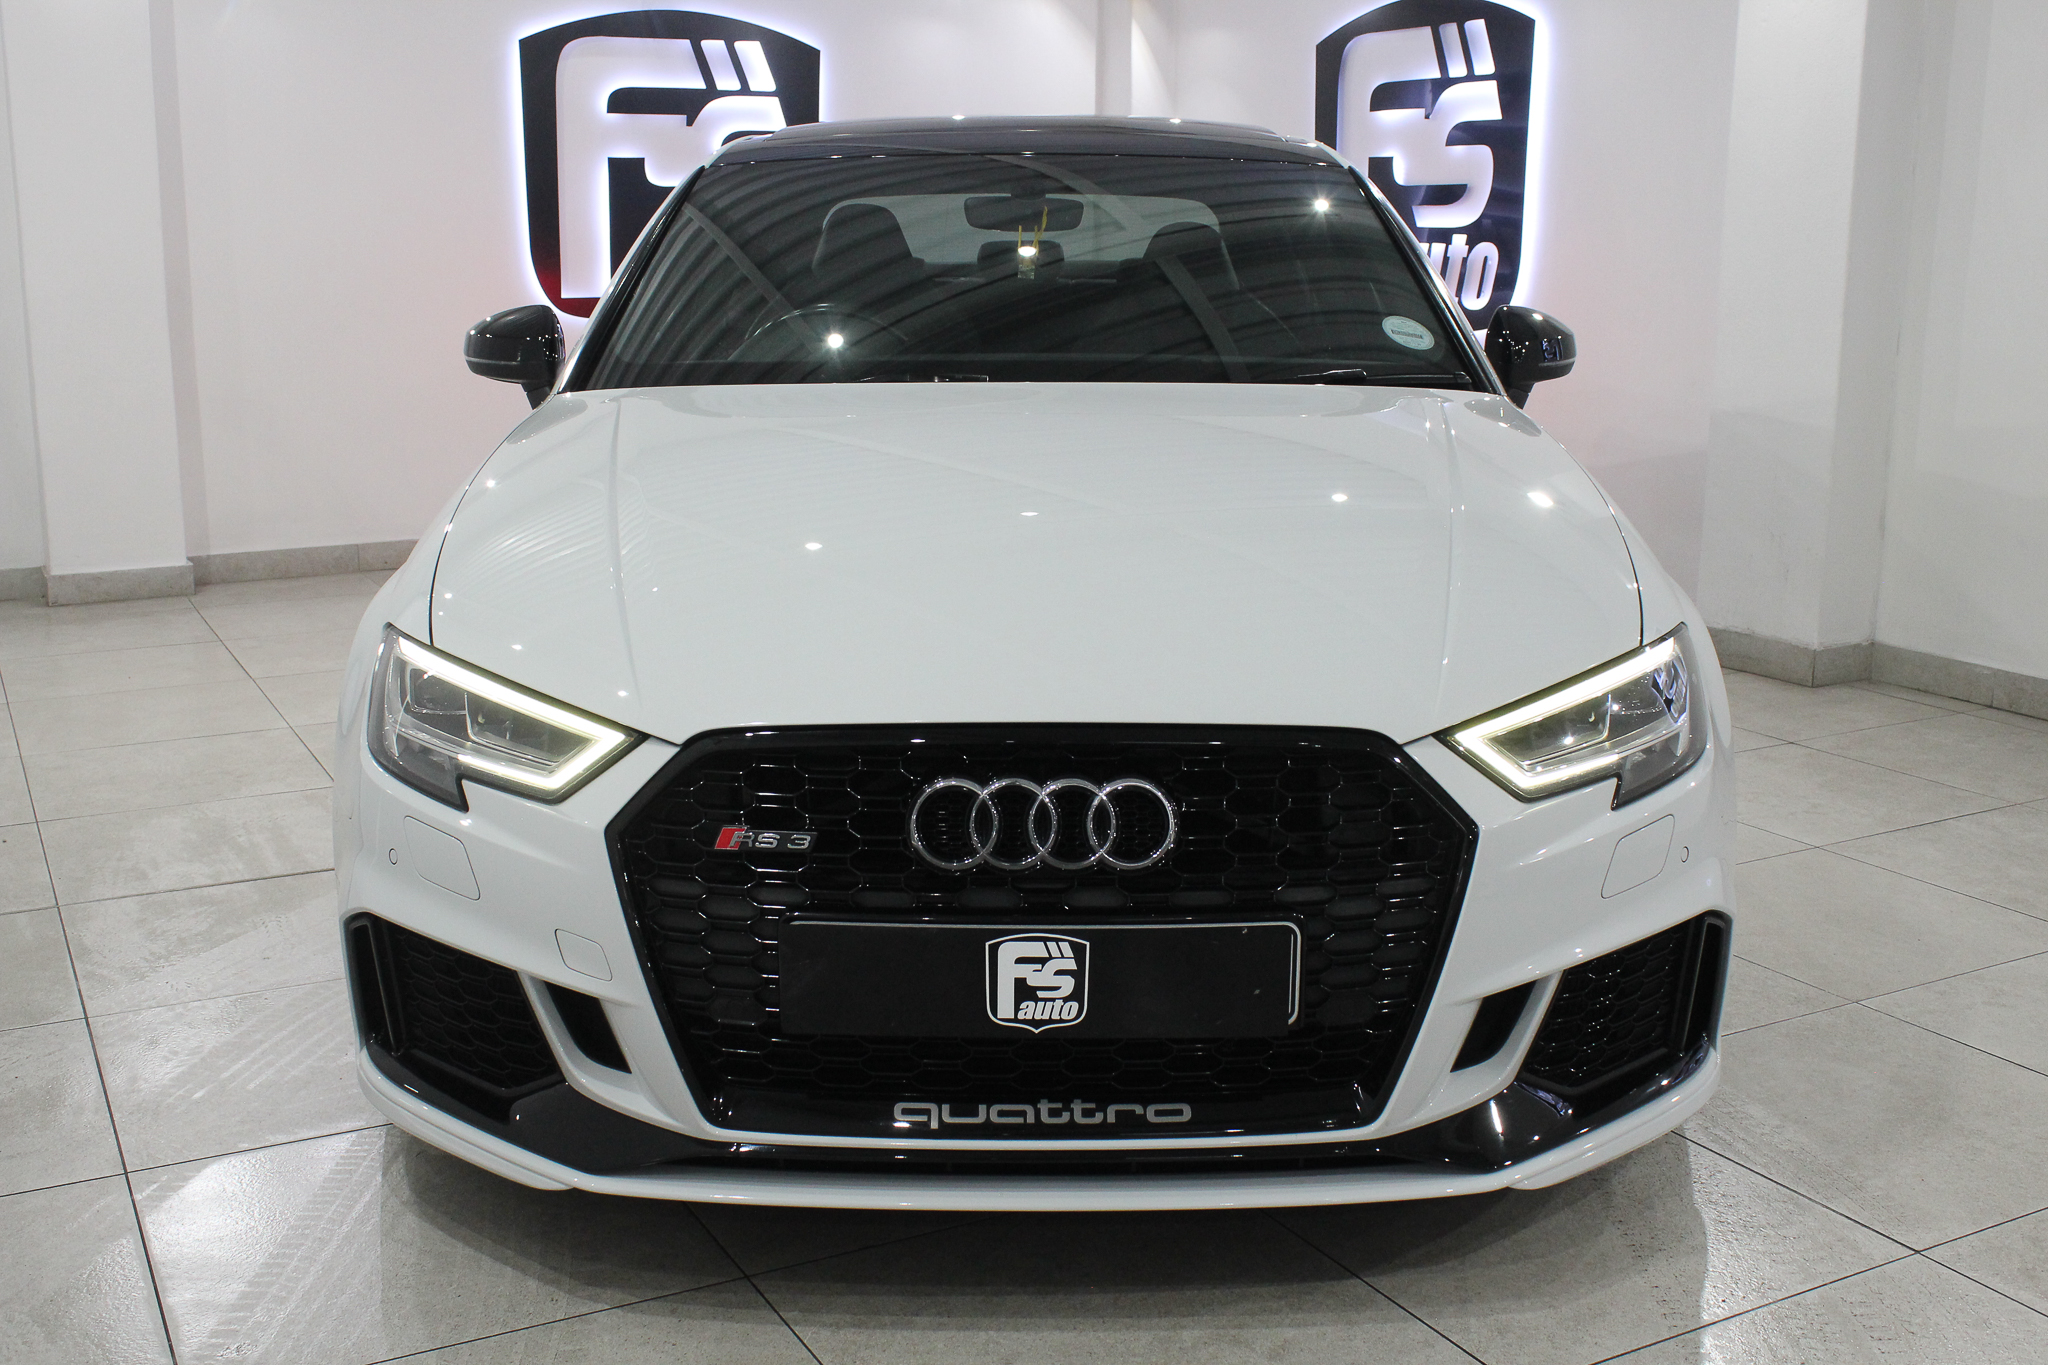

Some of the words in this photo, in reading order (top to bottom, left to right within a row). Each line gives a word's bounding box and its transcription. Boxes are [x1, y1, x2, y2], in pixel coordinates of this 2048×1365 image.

[1420, 233, 1499, 311] uto
[727, 830, 781, 849] RS
[787, 834, 811, 849] 3
[997, 941, 1078, 1019] FS
[1017, 999, 1080, 1020] auto
[893, 1098, 1192, 1130] quattro
